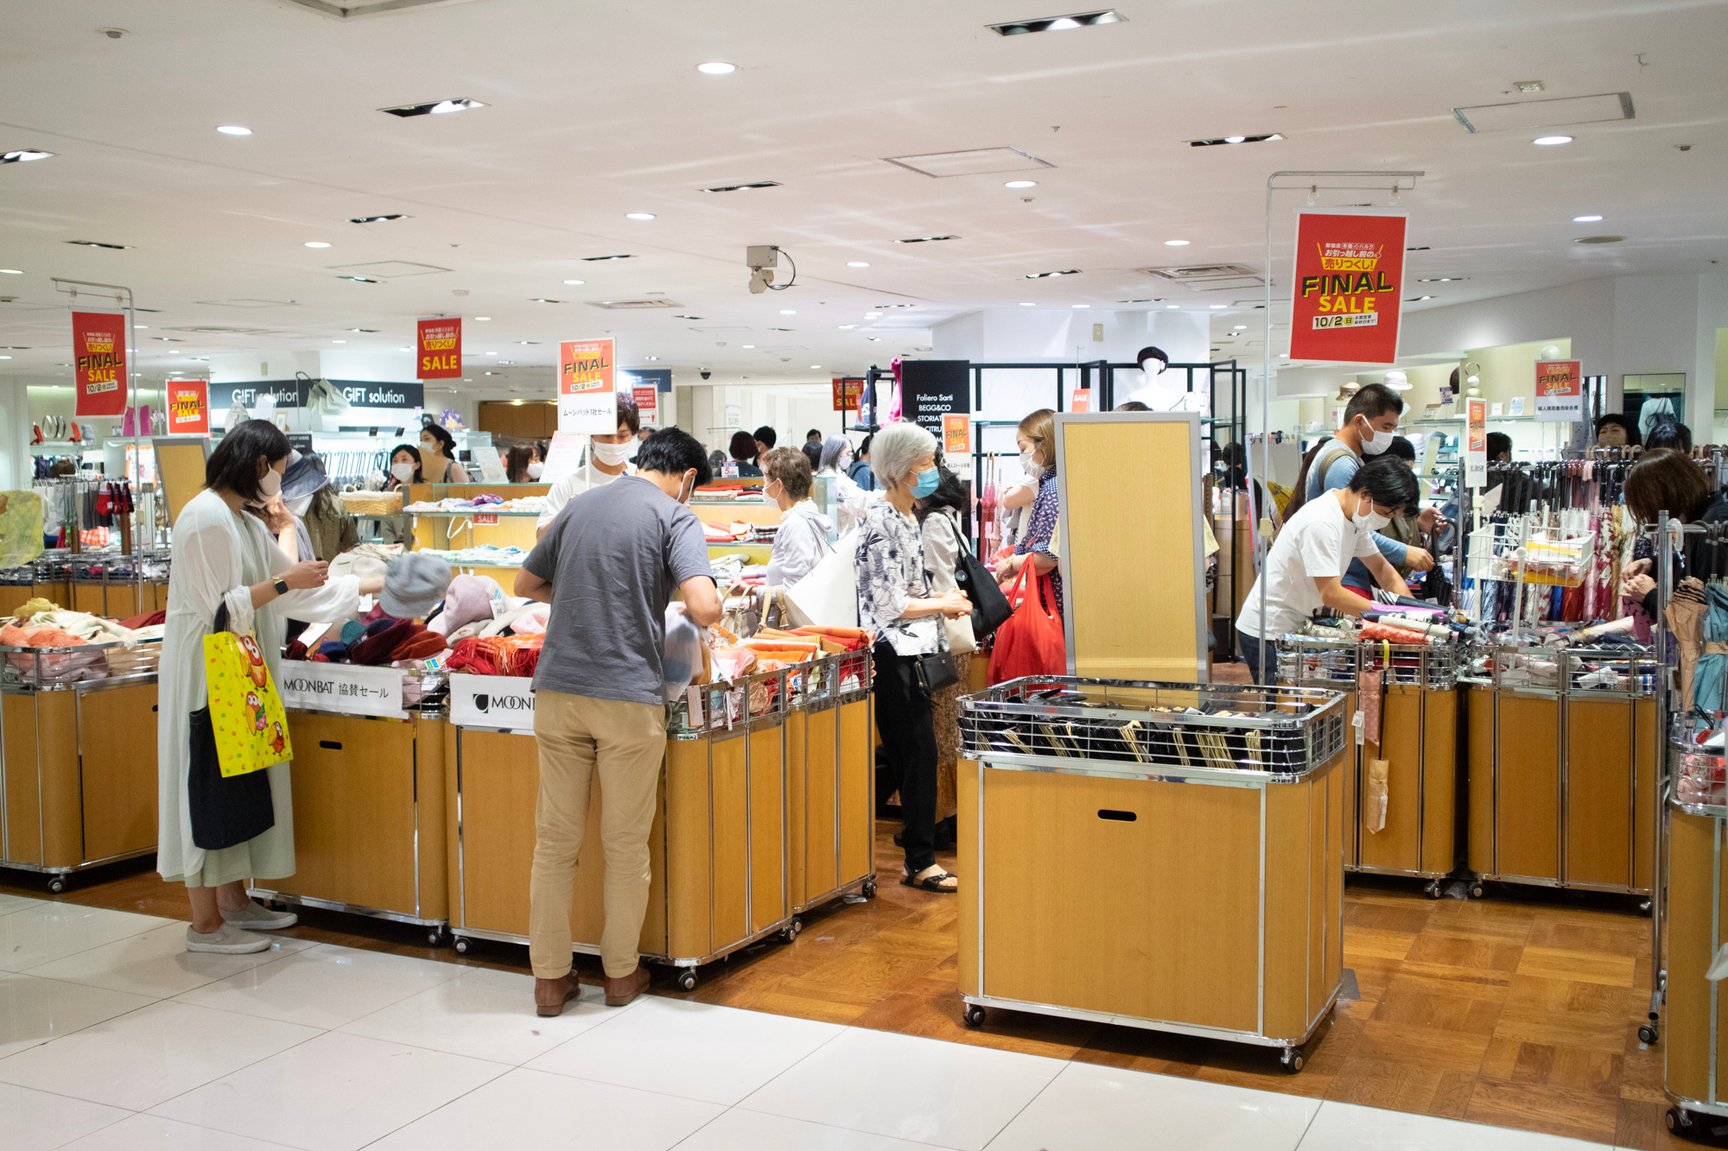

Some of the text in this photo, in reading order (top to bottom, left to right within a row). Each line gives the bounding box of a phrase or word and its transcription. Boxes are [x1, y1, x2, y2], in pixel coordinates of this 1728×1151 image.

[1325, 259, 1373, 270] 売りつくし!
[1302, 271, 1394, 298] FINAL
[1318, 296, 1376, 313] SALE
[1315, 316, 1343, 327] 10/2
[78, 352, 123, 372] FINAL
[423, 355, 457, 370] SALE
[564, 358, 609, 376] FINAL
[88, 370, 115, 382] SALE
[573, 371, 601, 383] SALE
[1539, 373, 1577, 384] FINAL
[232, 388, 256, 403] GIFT
[343, 387, 405, 403] GIFT solution
[170, 400, 205, 412] FINAL
[283, 678, 389, 698] MOONBAT 協賛セール
